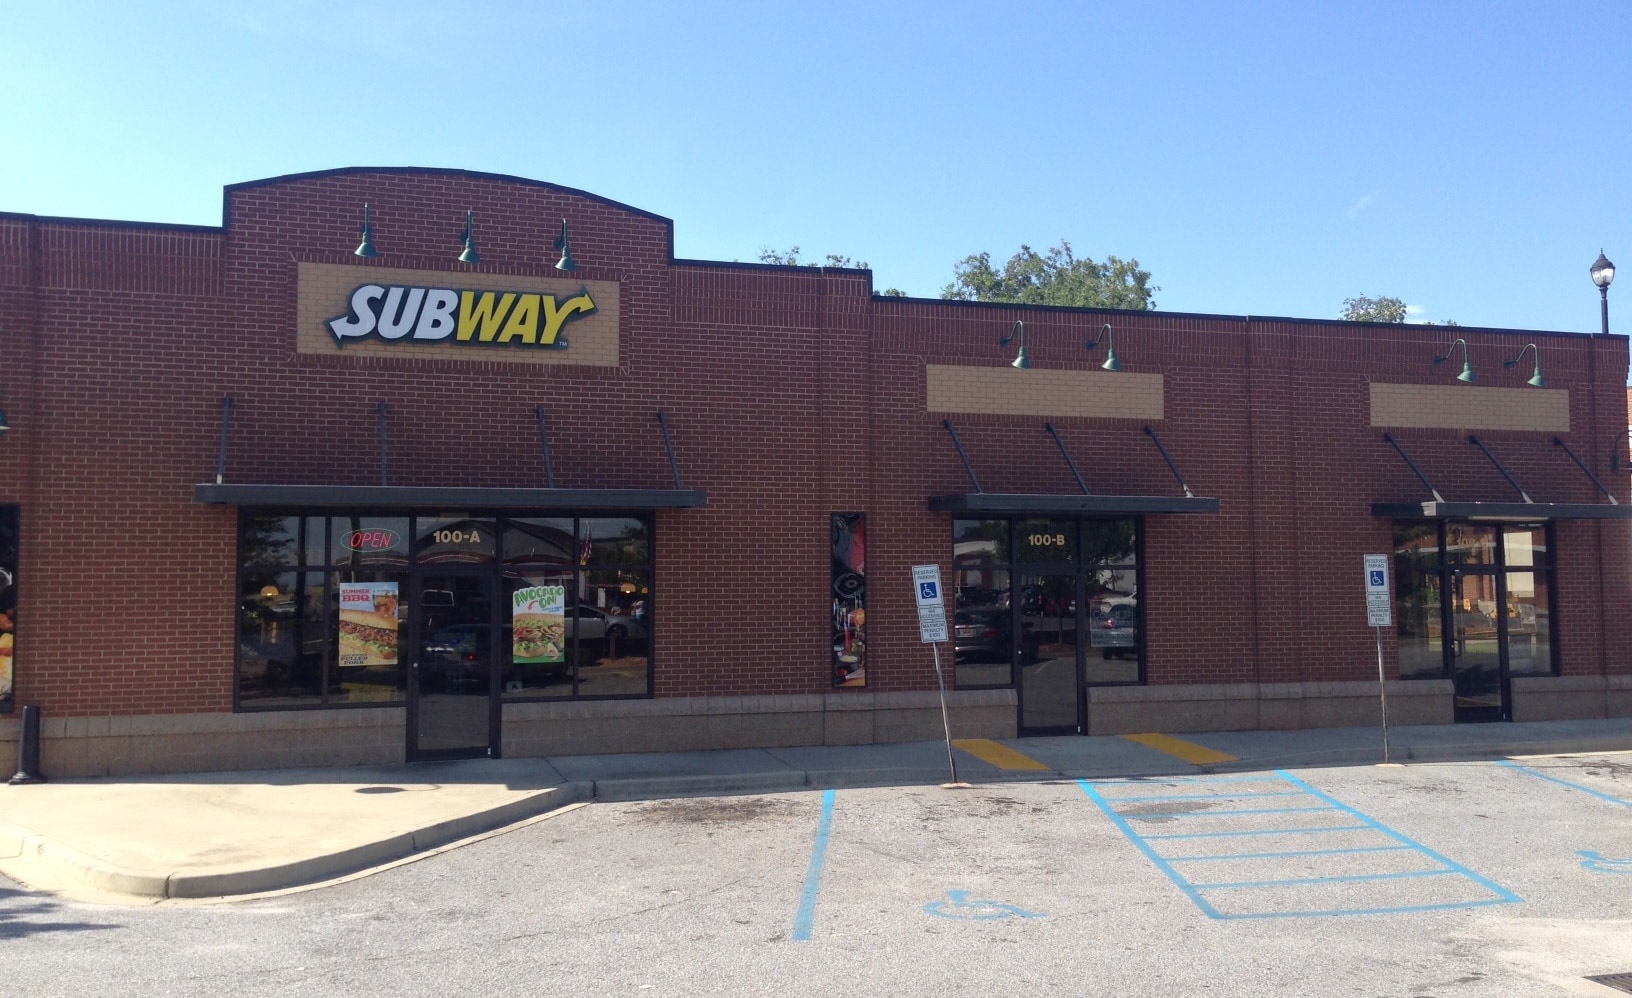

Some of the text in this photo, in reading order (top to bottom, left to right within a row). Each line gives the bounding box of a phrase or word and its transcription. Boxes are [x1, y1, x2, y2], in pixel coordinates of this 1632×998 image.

[329, 285, 595, 345] SUBWAY
[351, 532, 392, 548] OPEN
[433, 530, 481, 543] 100-A
[1028, 534, 1066, 546] 100-B
[342, 594, 371, 602] BBQ
[514, 587, 564, 607] AVOCADO
[539, 595, 557, 609] ON!
